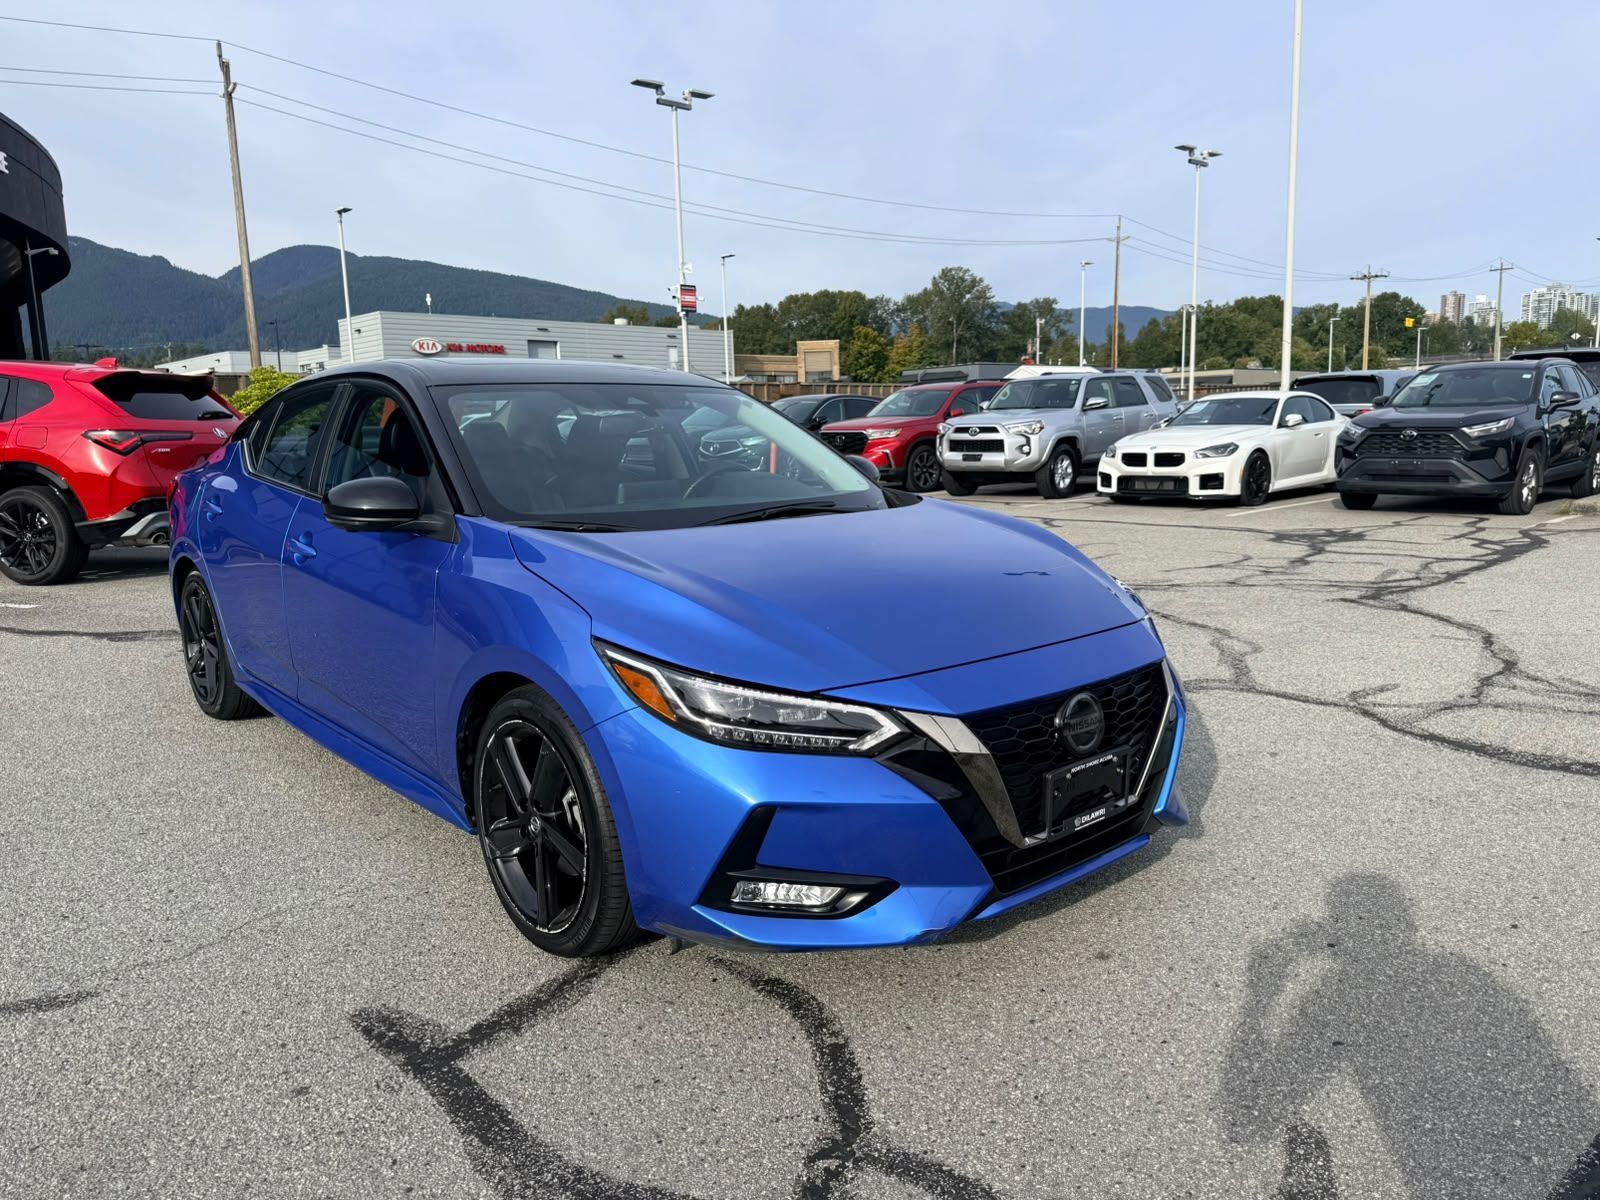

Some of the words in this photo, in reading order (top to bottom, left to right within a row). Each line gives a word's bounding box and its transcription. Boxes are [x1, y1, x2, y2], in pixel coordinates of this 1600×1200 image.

[418, 341, 438, 351] KIA
[447, 343, 463, 352] KIA
[466, 344, 504, 353] MOTORS
[1071, 764, 1085, 773] NORTH
[1086, 758, 1099, 768] SHORE
